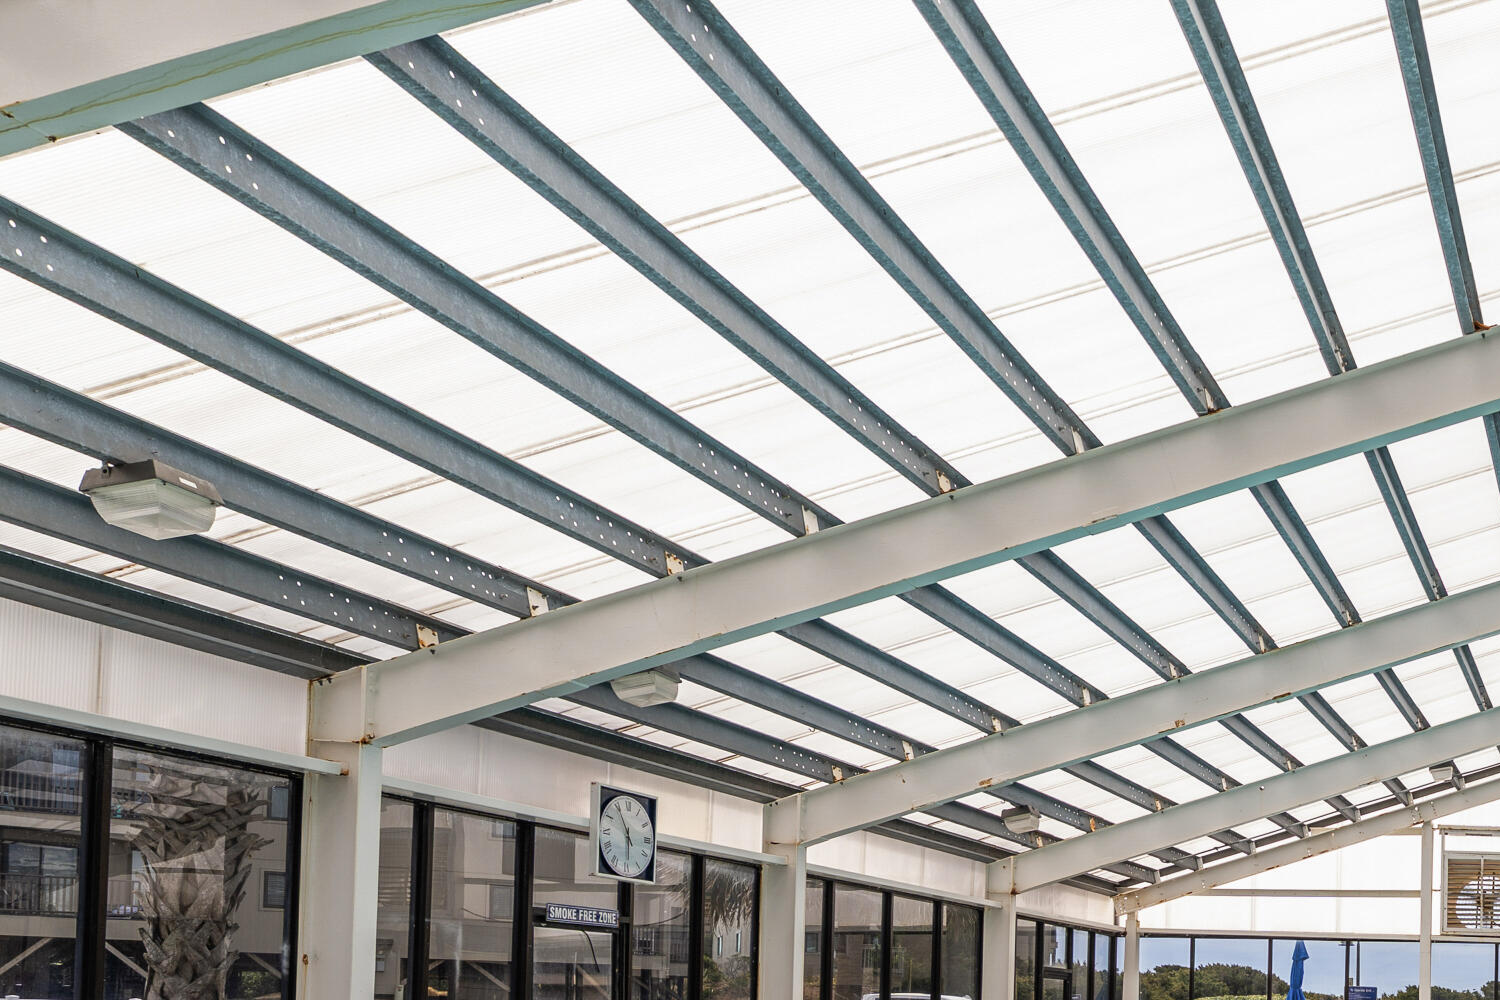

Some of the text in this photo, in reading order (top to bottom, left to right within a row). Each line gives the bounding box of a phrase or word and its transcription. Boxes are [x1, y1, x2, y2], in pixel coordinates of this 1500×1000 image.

[549, 906, 616, 924] SMOKE FREE ZONE
